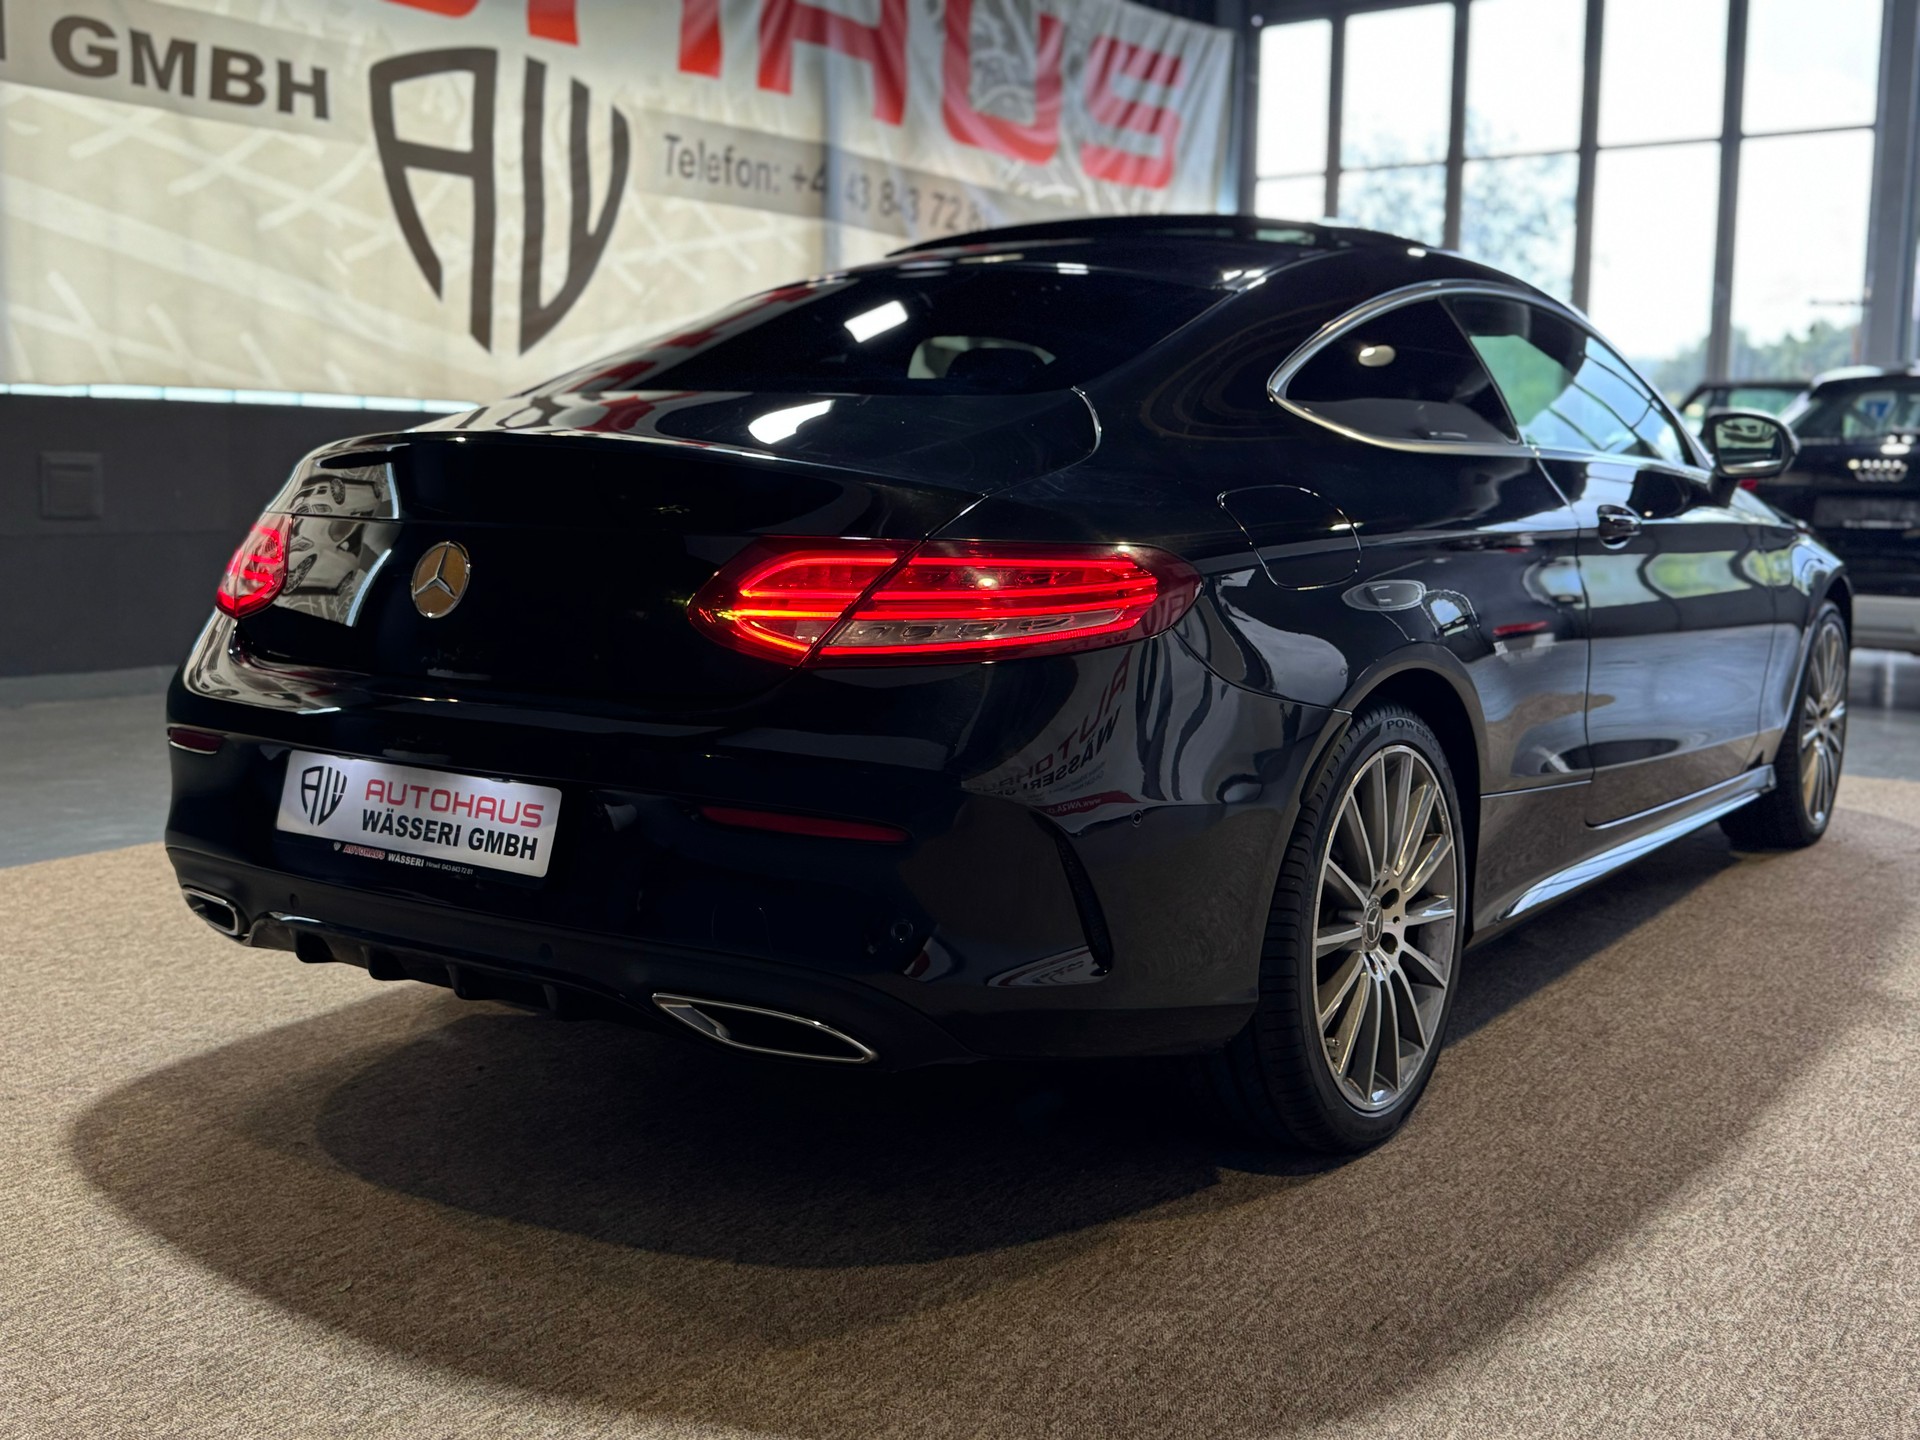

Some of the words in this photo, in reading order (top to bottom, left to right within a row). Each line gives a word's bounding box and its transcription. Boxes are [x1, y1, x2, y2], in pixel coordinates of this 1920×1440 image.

[50, 15, 330, 121] GMBH
[663, 132, 781, 195] Telefon:
[365, 779, 545, 829] AUTOHAUS
[343, 844, 386, 860] AUTOHAUS
[362, 808, 462, 847] WÄSSERI
[468, 827, 538, 861] GMBH
